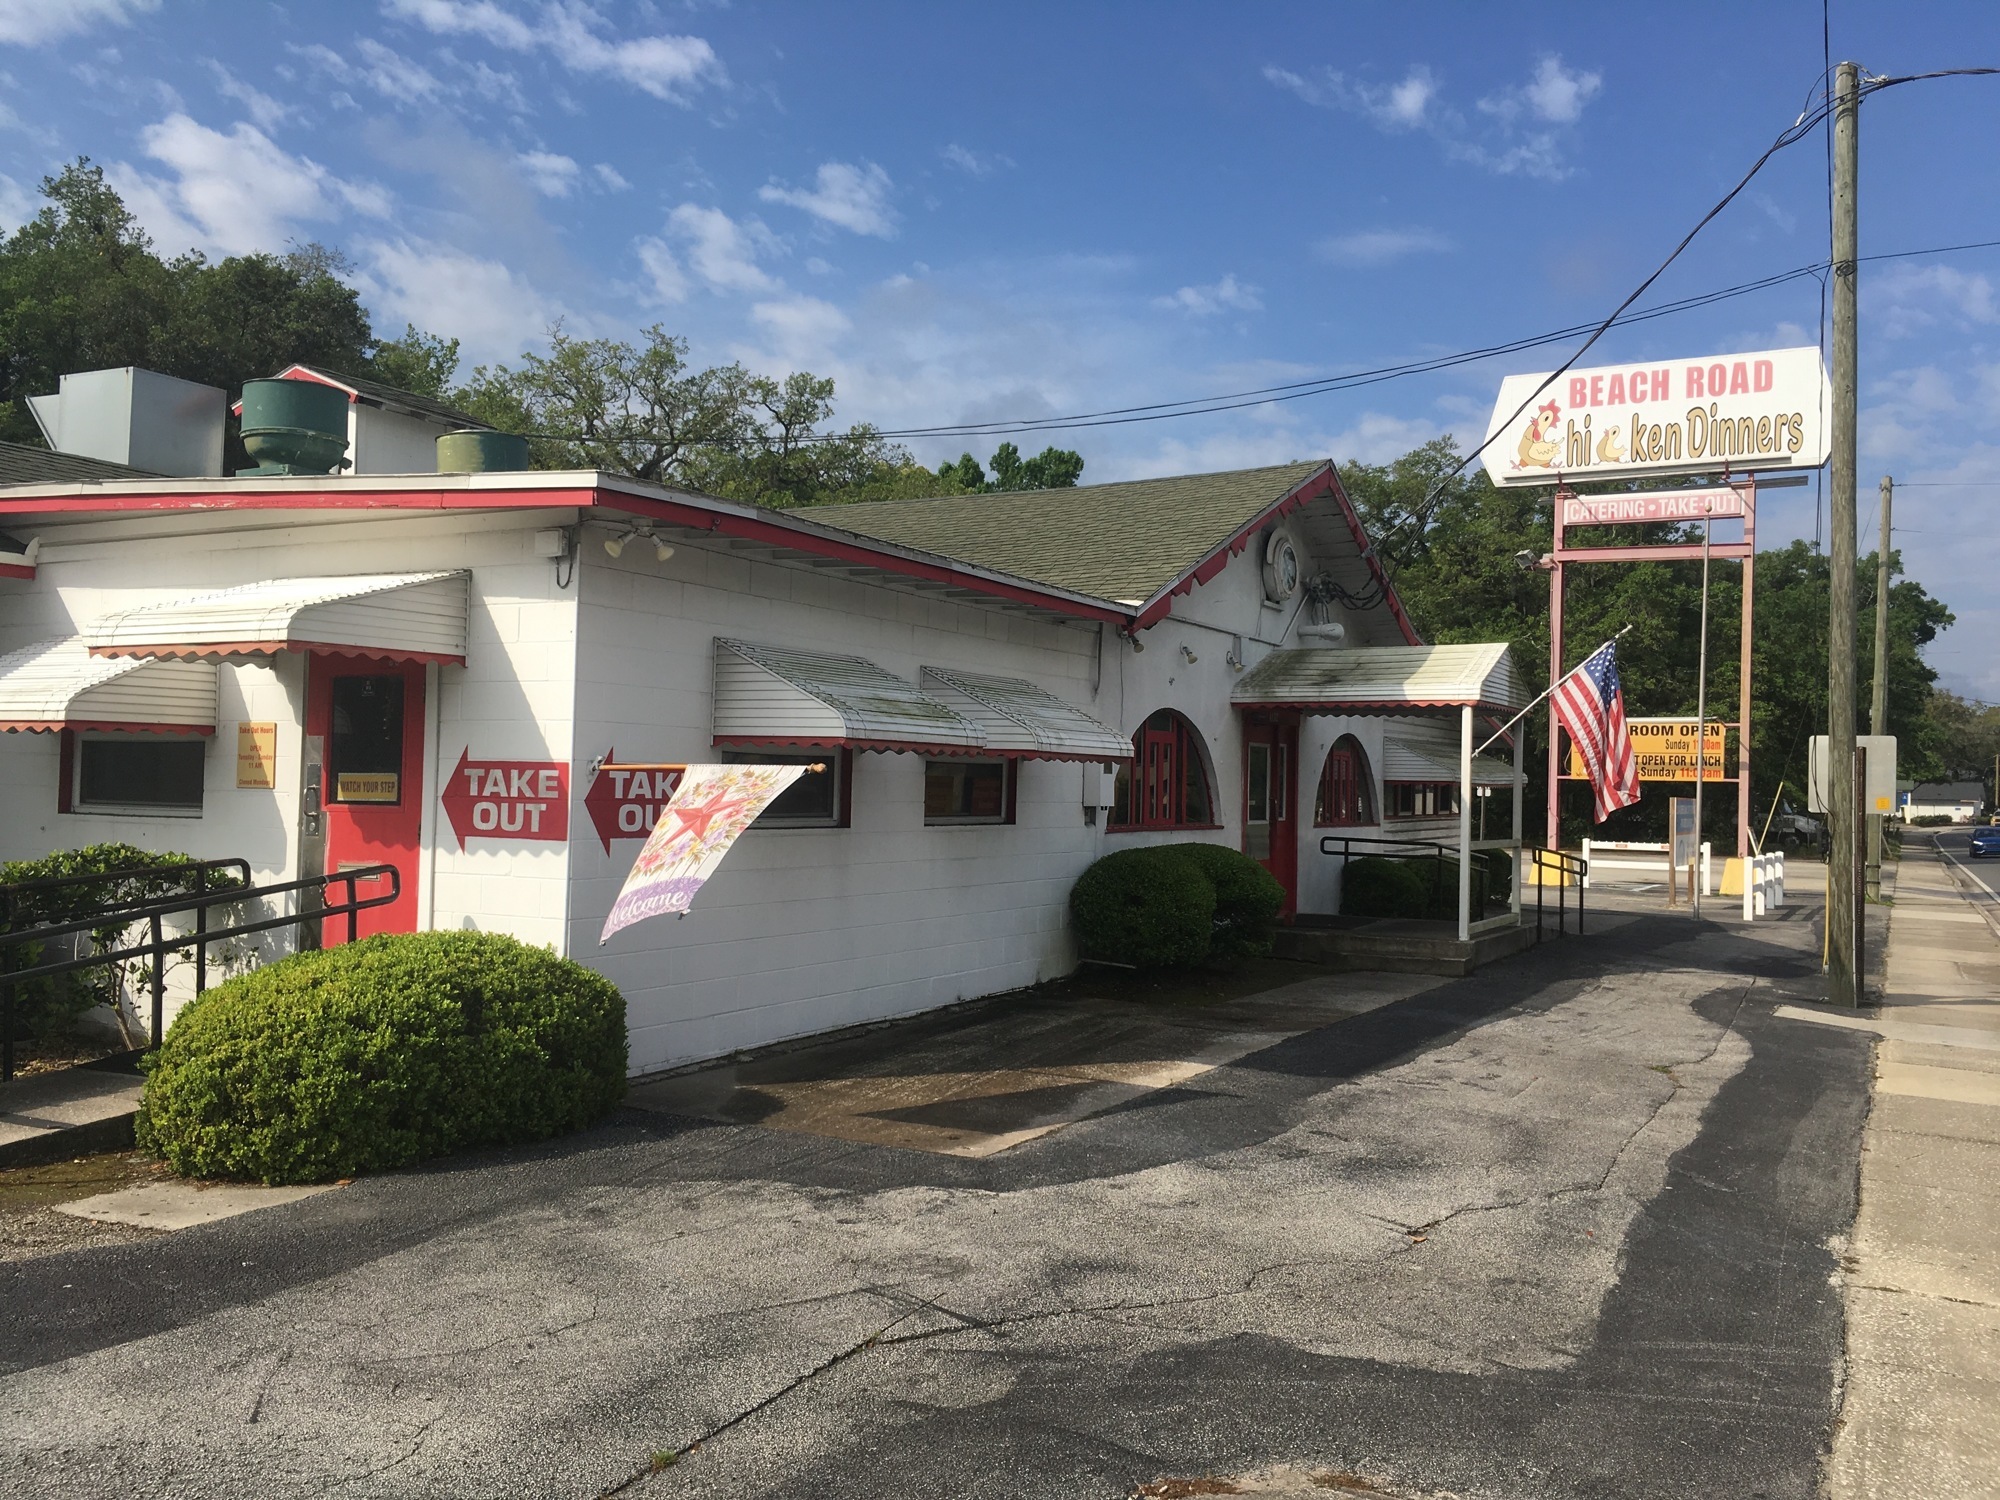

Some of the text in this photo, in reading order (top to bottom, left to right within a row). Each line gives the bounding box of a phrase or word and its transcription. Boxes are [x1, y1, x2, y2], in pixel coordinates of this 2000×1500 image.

[1569, 359, 1773, 409] BEACH ROAD
[1686, 402, 1804, 459] Dinners
[1570, 494, 1738, 520] CATERING TAKE-OUT
[1629, 725, 1720, 736] ROOM OPEN
[1665, 738, 1690, 752] Sunday
[1641, 755, 1666, 766] OPEN
[1668, 755, 1687, 766] FOR
[341, 781, 396, 793] WATCH YOUR STEP
[464, 768, 559, 798] TAKE
[609, 770, 684, 799] TAK
[473, 801, 547, 832] OUT
[618, 803, 667, 832] OU
[608, 890, 688, 929] Welcome
